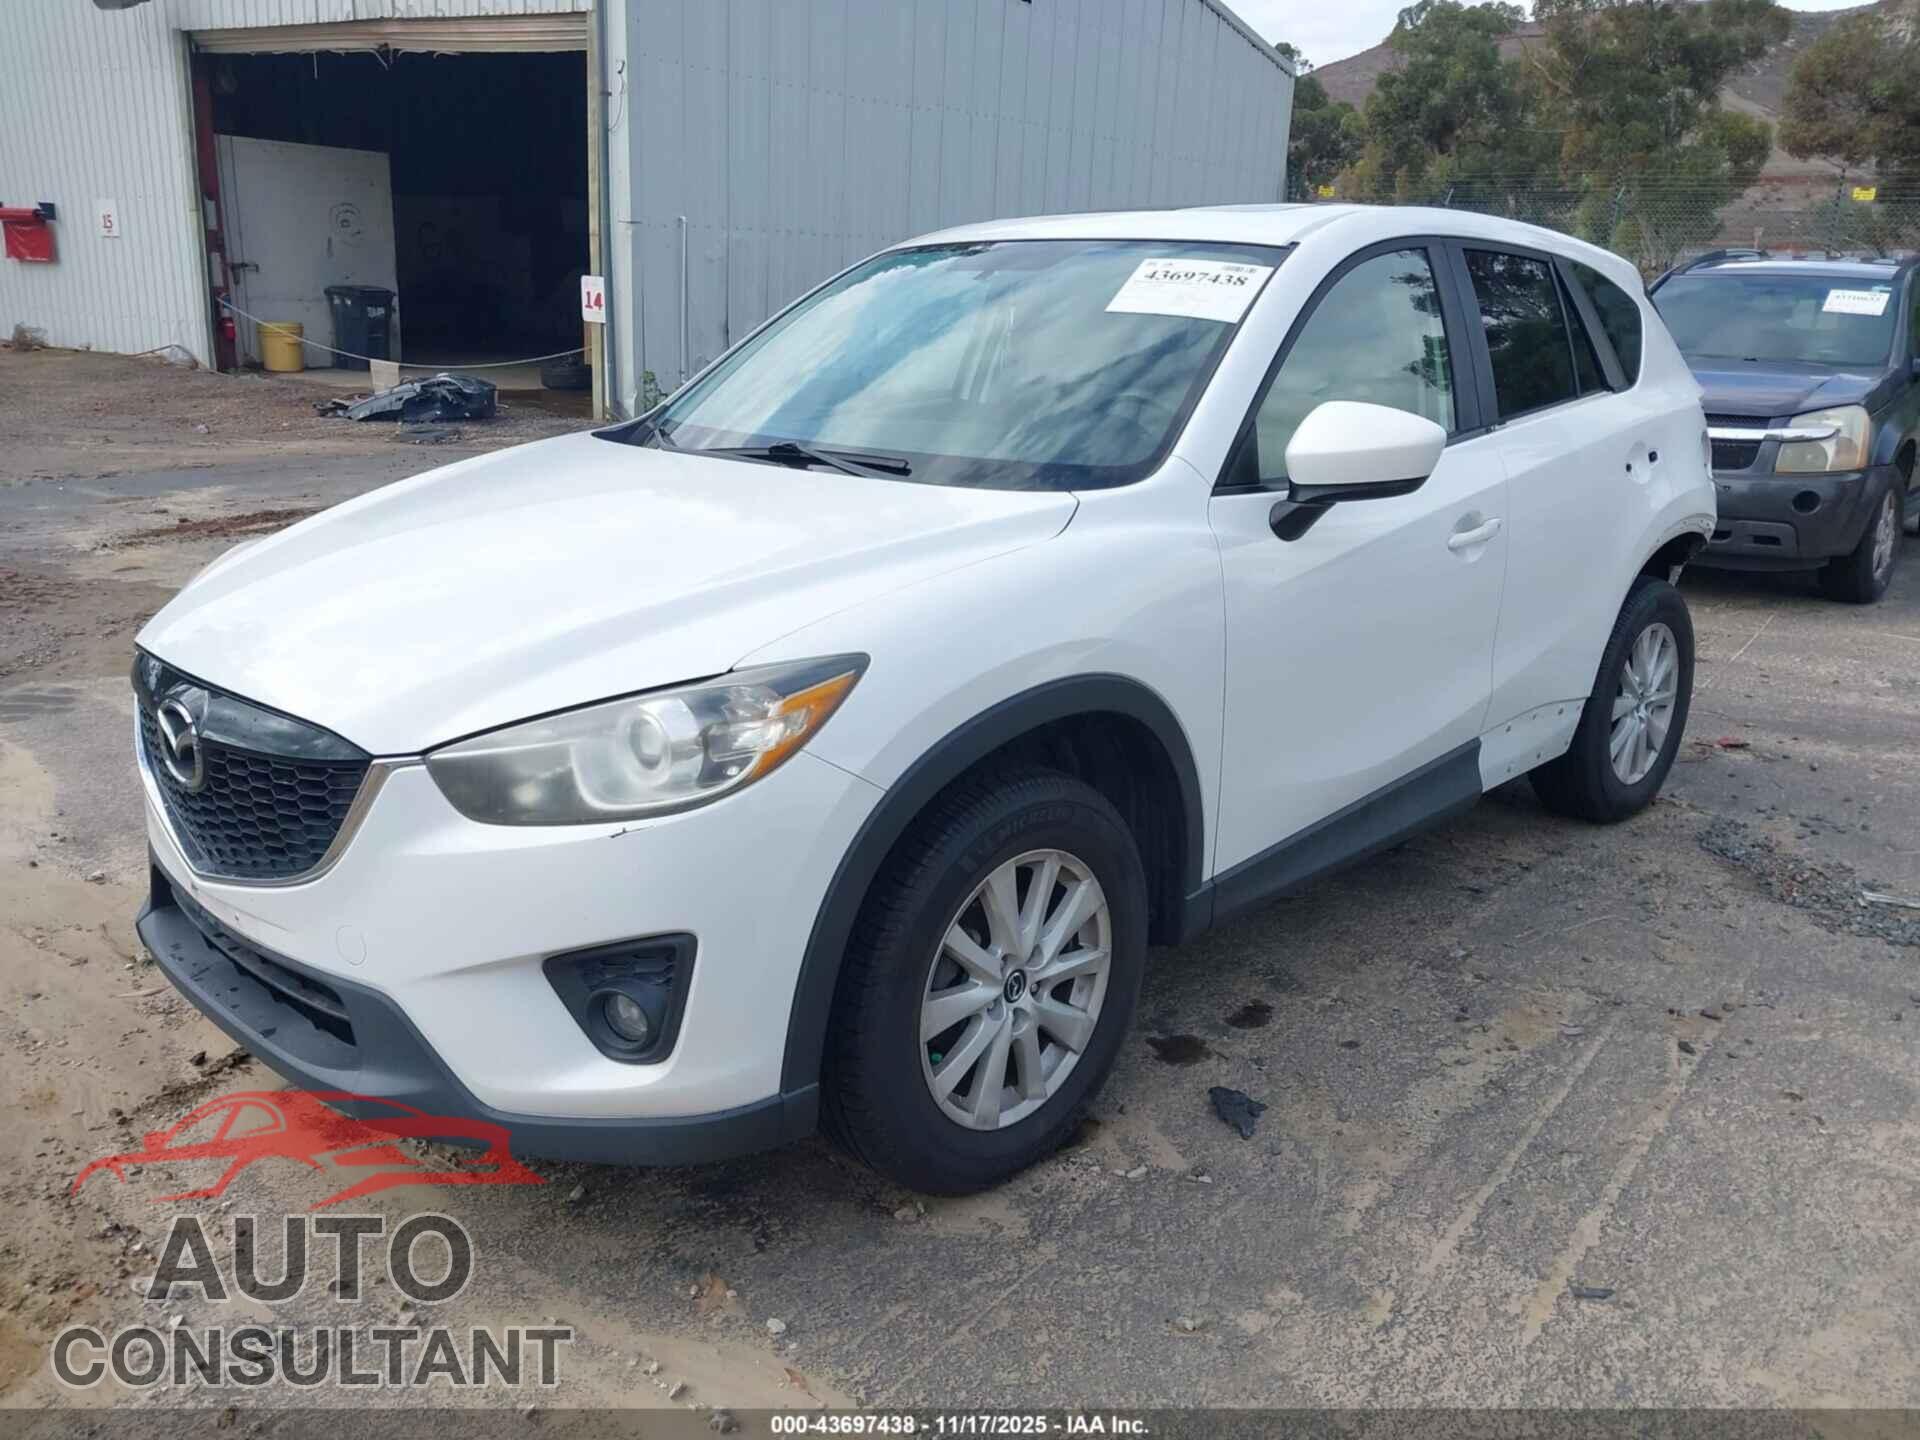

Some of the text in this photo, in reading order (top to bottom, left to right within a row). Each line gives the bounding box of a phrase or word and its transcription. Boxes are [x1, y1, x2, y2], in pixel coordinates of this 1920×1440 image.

[102, 213, 113, 229] 15
[1143, 269, 1249, 286] 43697438
[584, 290, 603, 311] 14
